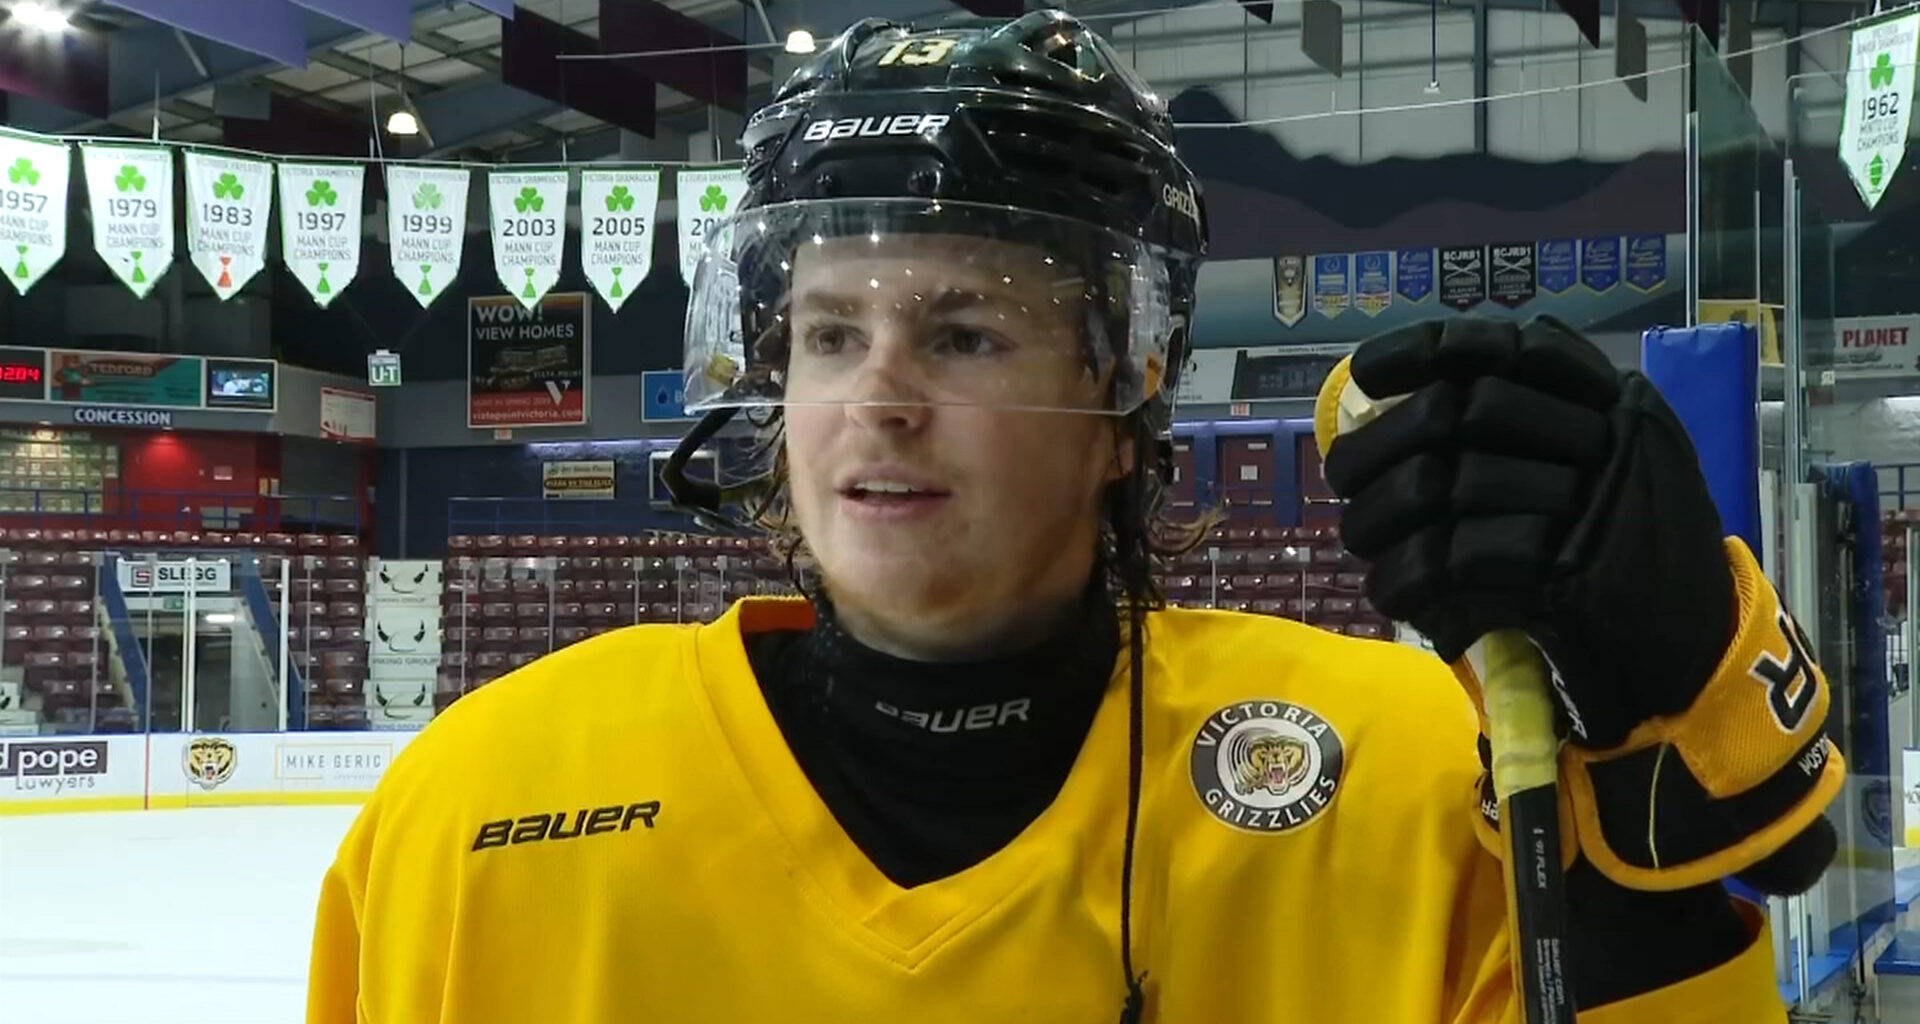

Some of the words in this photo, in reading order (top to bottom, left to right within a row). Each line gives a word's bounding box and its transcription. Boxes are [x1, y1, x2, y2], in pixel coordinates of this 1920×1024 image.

[878, 38, 957, 66] 13
[1862, 91, 1899, 120] 1962
[803, 114, 950, 141] BAUER
[1857, 131, 1899, 152] CHAMPIONS
[108, 198, 158, 218] 1979
[203, 203, 253, 227] 1983
[28, 217, 49, 232] CUP
[108, 222, 138, 235] MANN
[140, 223, 160, 236] CUP
[297, 211, 346, 231] 1997
[402, 214, 453, 235] 1999
[503, 218, 556, 237] 2003
[592, 217, 645, 236] 2005
[106, 234, 165, 249] CHAMPIONS
[200, 227, 230, 241] MANN
[232, 231, 253, 243] CUP
[297, 235, 326, 247] MANN
[328, 236, 348, 248] CUP
[197, 240, 256, 256] CHAMPIONS
[294, 248, 352, 261] CHAMPIONS
[402, 238, 430, 250] MANN
[432, 240, 452, 252] CUP
[505, 242, 532, 253] MANN
[534, 241, 553, 252] CUP
[594, 241, 621, 252] MANN
[623, 240, 641, 252] CUP
[397, 250, 455, 265] CHAMPIONS
[503, 253, 556, 266] CHAMPIONS
[591, 252, 643, 266] CHAMPIONS
[476, 304, 543, 322] WOW!
[475, 325, 515, 341] VIEW
[519, 323, 575, 340] HOMES
[1843, 326, 1910, 348] PLANET
[74, 407, 171, 426] CONCESSION
[1196, 702, 1329, 747] VICTORIA
[18, 747, 98, 776] pope
[286, 755, 325, 768] MIKE
[333, 754, 382, 768] GERIC
[1205, 776, 1336, 828] GRIZZLIES
[471, 800, 661, 852] BAUER
[1536, 855, 1548, 889] FLEX
